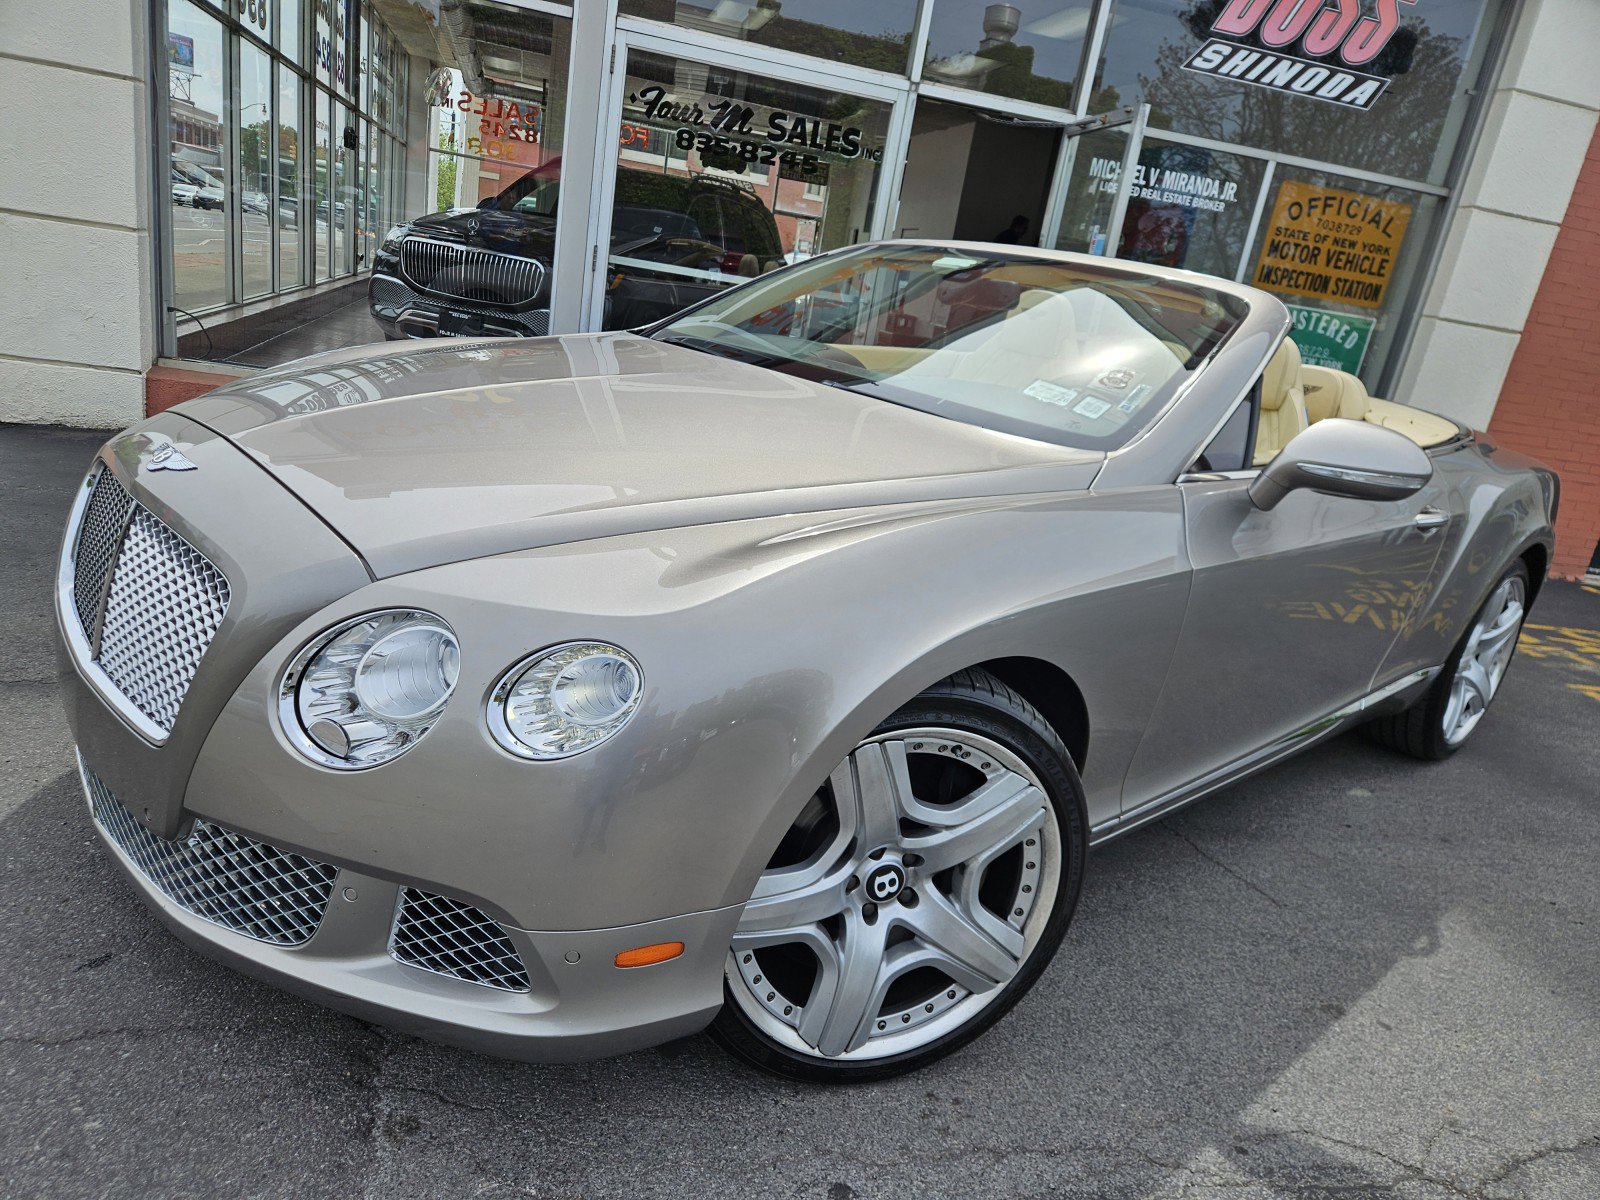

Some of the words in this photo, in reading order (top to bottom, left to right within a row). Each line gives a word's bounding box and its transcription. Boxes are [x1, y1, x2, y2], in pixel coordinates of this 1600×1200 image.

[1191, 43, 1381, 106] SHINODA
[639, 86, 703, 126] Four
[708, 100, 755, 136] M
[766, 111, 862, 158] SALES
[1089, 158, 1147, 185] MICHEL
[1162, 170, 1220, 198] MIRANDA
[1100, 181, 1141, 197] LICEED
[1140, 188, 1162, 201] REAL
[1162, 192, 1192, 207] ESTATE
[1191, 197, 1226, 212] BROKER
[1287, 196, 1395, 239] OFFICIAL
[1267, 238, 1321, 266] MOTOR
[1325, 249, 1390, 278] VEHICLE
[1274, 226, 1310, 241] STATE
[1313, 232, 1330, 244] OF
[1332, 237, 1358, 250] NEW
[1362, 241, 1391, 256] YORK
[1257, 264, 1331, 294] INSPECTION
[1331, 277, 1383, 302] STATION
[1291, 309, 1359, 350] ISTERED
[874, 870, 899, 898] B
